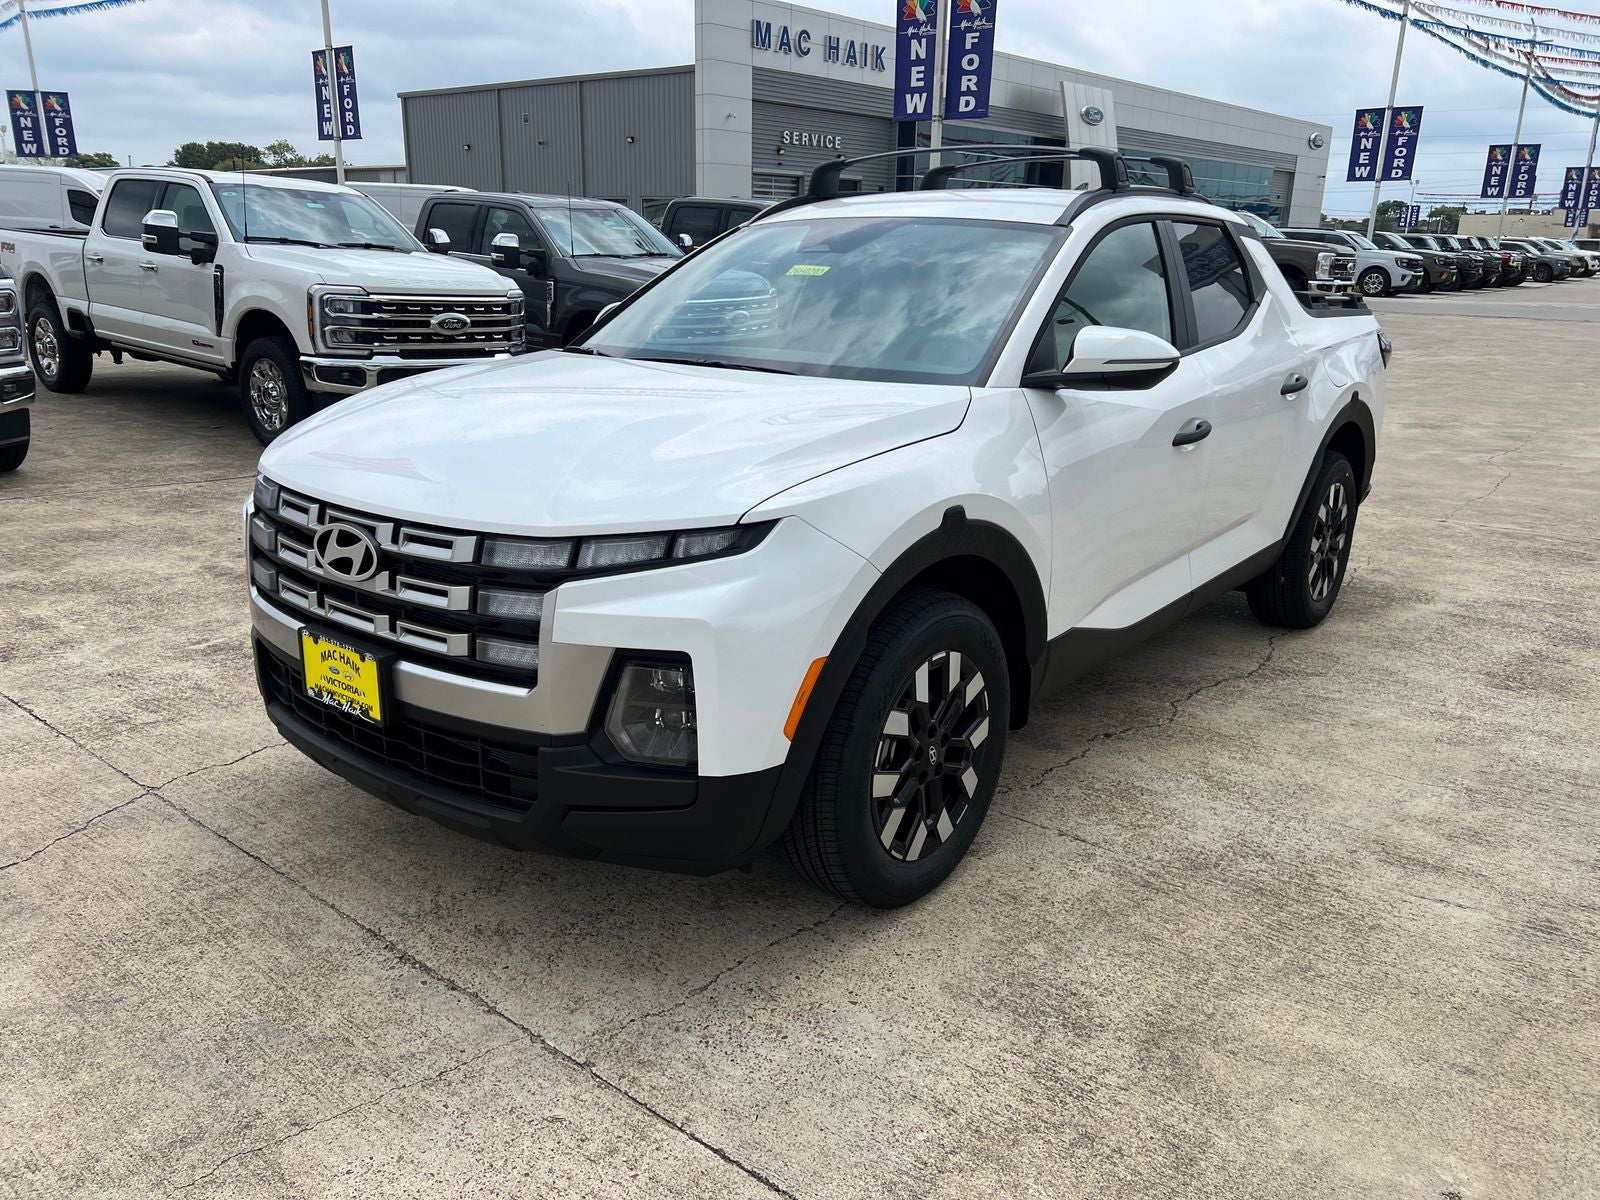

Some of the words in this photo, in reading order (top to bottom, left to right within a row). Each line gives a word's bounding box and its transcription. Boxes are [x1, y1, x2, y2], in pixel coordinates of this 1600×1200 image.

[752, 19, 812, 58] MAC
[825, 35, 887, 72] HAIK
[905, 37, 928, 114] NEW
[958, 32, 980, 113] FORD
[321, 86, 334, 136] NEW
[343, 84, 355, 136] FORD
[19, 117, 38, 154] NEW
[54, 117, 70, 155] FORD
[783, 130, 842, 149] SERVICE
[1354, 138, 1373, 178] NEW
[1390, 136, 1409, 178] FORD
[1487, 166, 1502, 196] NEW
[1515, 165, 1530, 197] FORD
[1564, 183, 1577, 208] NEW
[1587, 183, 1599, 208] FORD
[320, 649, 338, 664] MAC
[339, 651, 362, 679] HAIK
[326, 674, 360, 696] VICTORIA
[321, 692, 339, 707] Mac
[341, 701, 363, 716] Haik
